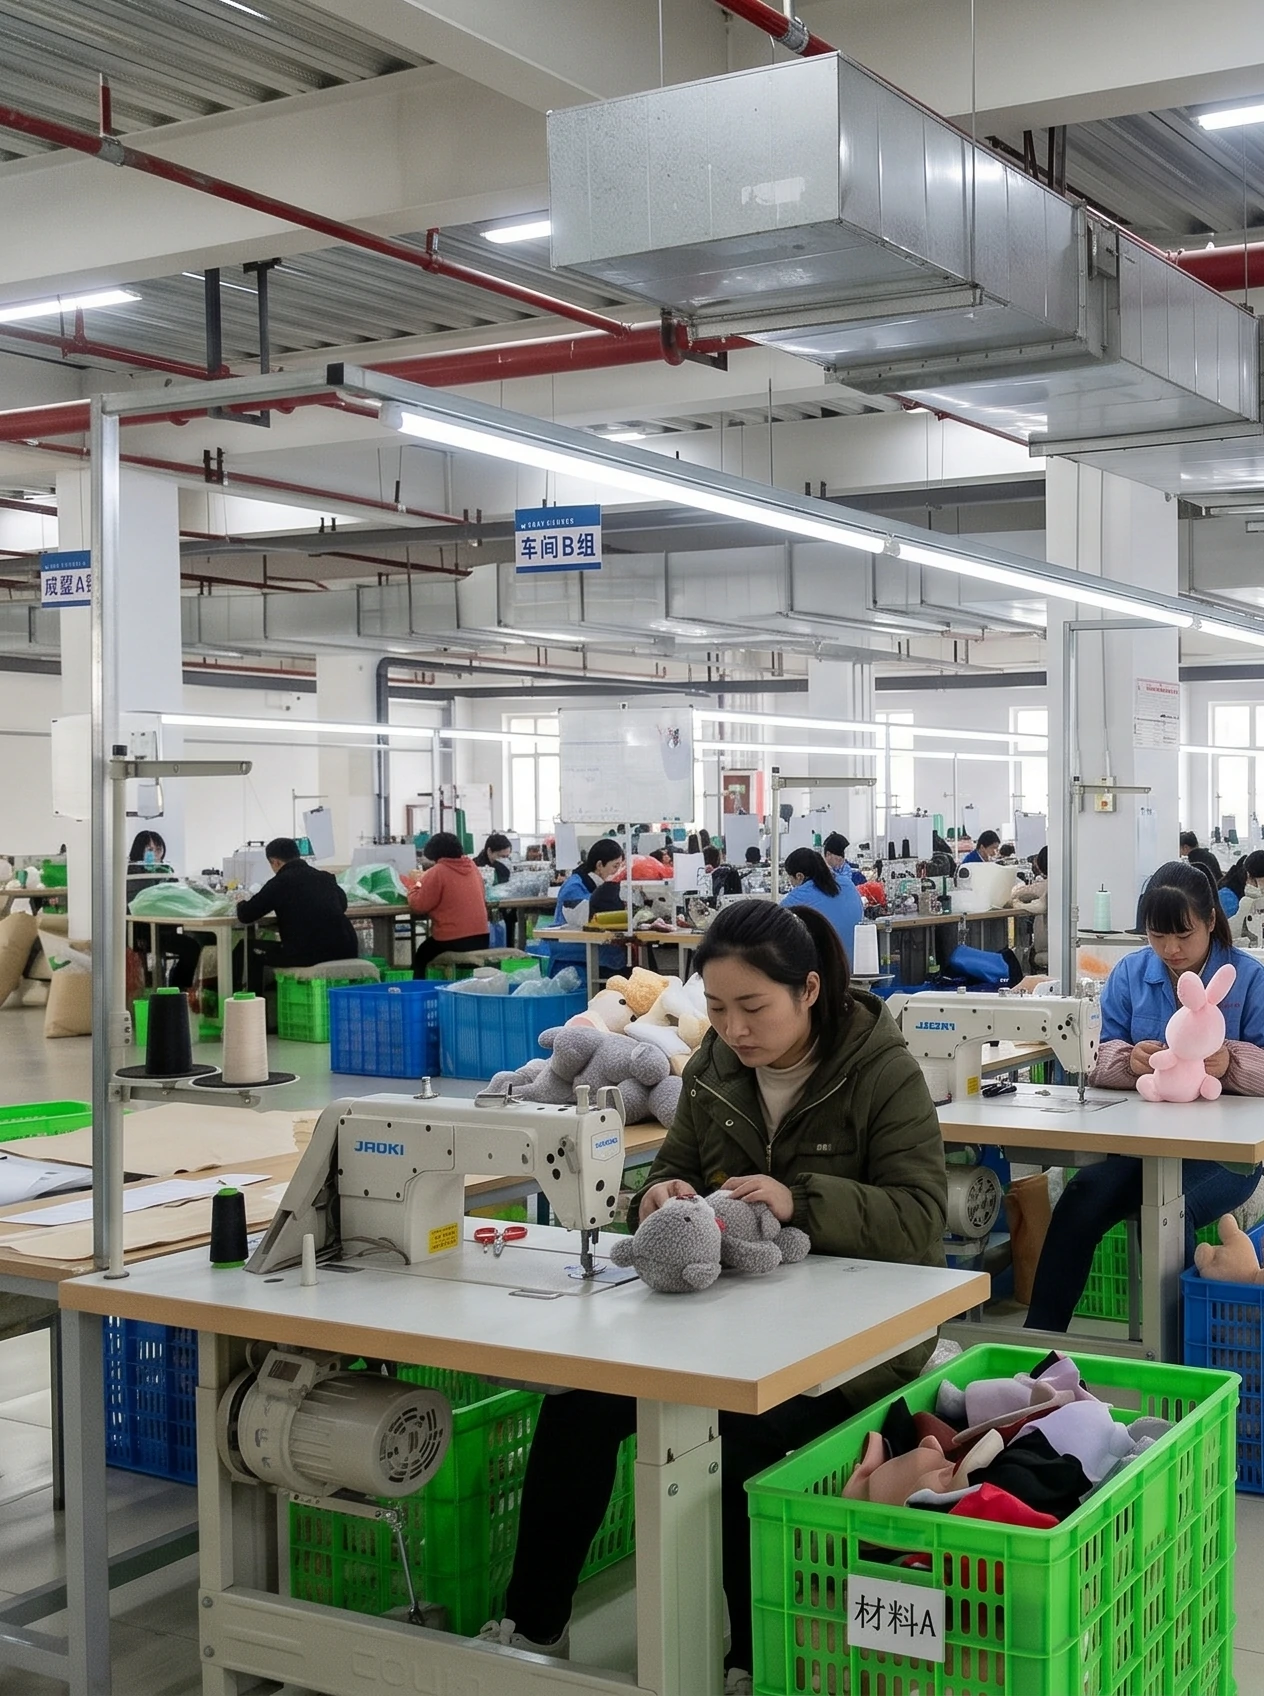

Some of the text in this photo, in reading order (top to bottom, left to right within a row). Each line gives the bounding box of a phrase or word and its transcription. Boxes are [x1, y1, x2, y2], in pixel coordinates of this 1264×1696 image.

[521, 533, 596, 560] 车间B组
[854, 1594, 936, 1638] 材料A
